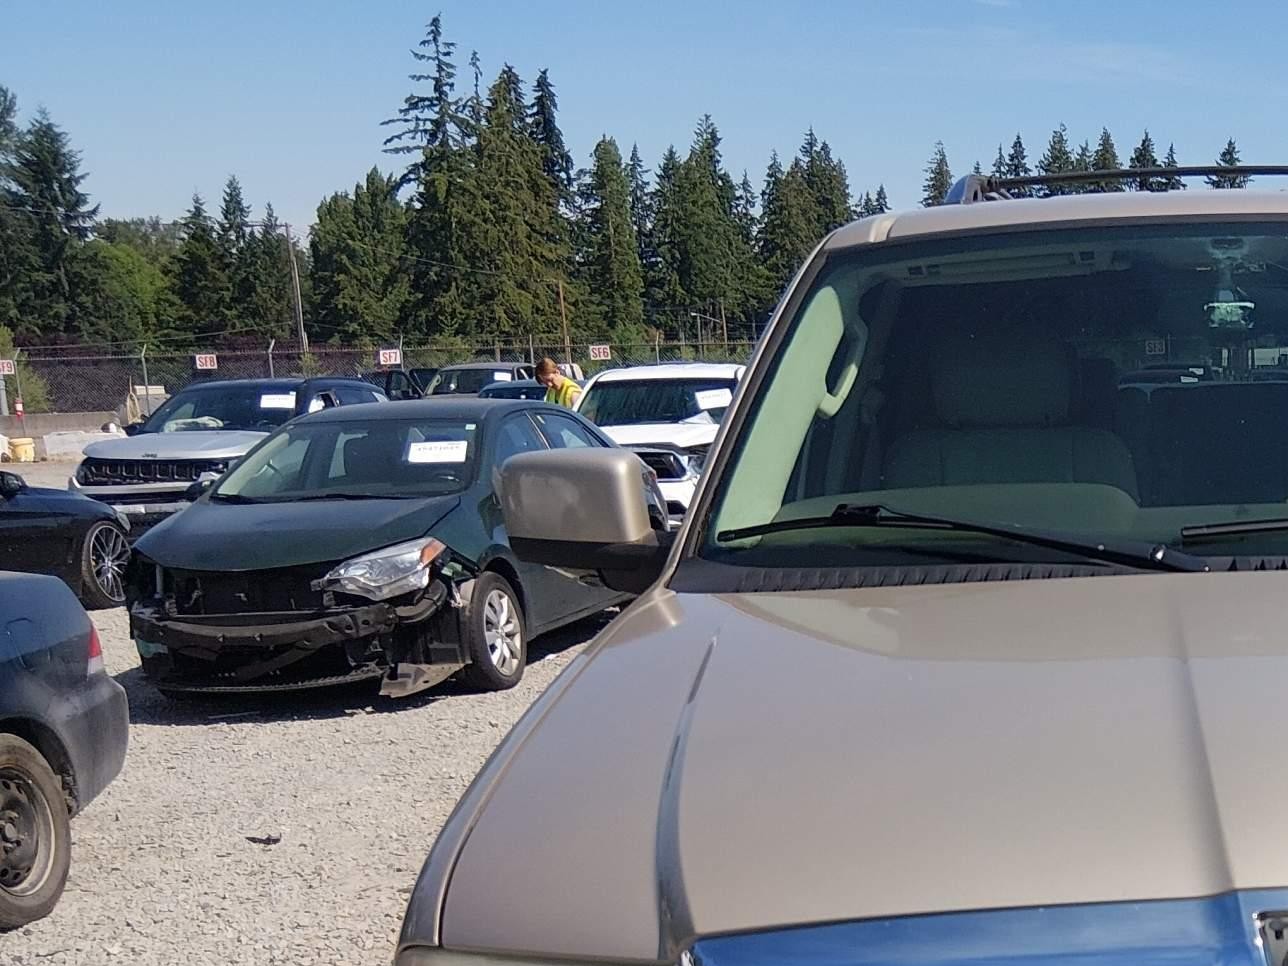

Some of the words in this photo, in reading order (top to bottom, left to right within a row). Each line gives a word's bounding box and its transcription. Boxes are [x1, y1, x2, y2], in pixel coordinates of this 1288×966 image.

[382, 352, 398, 363] SF7
[591, 347, 609, 358] SF6
[0, 361, 12, 373] F9
[198, 356, 216, 367] SF8
